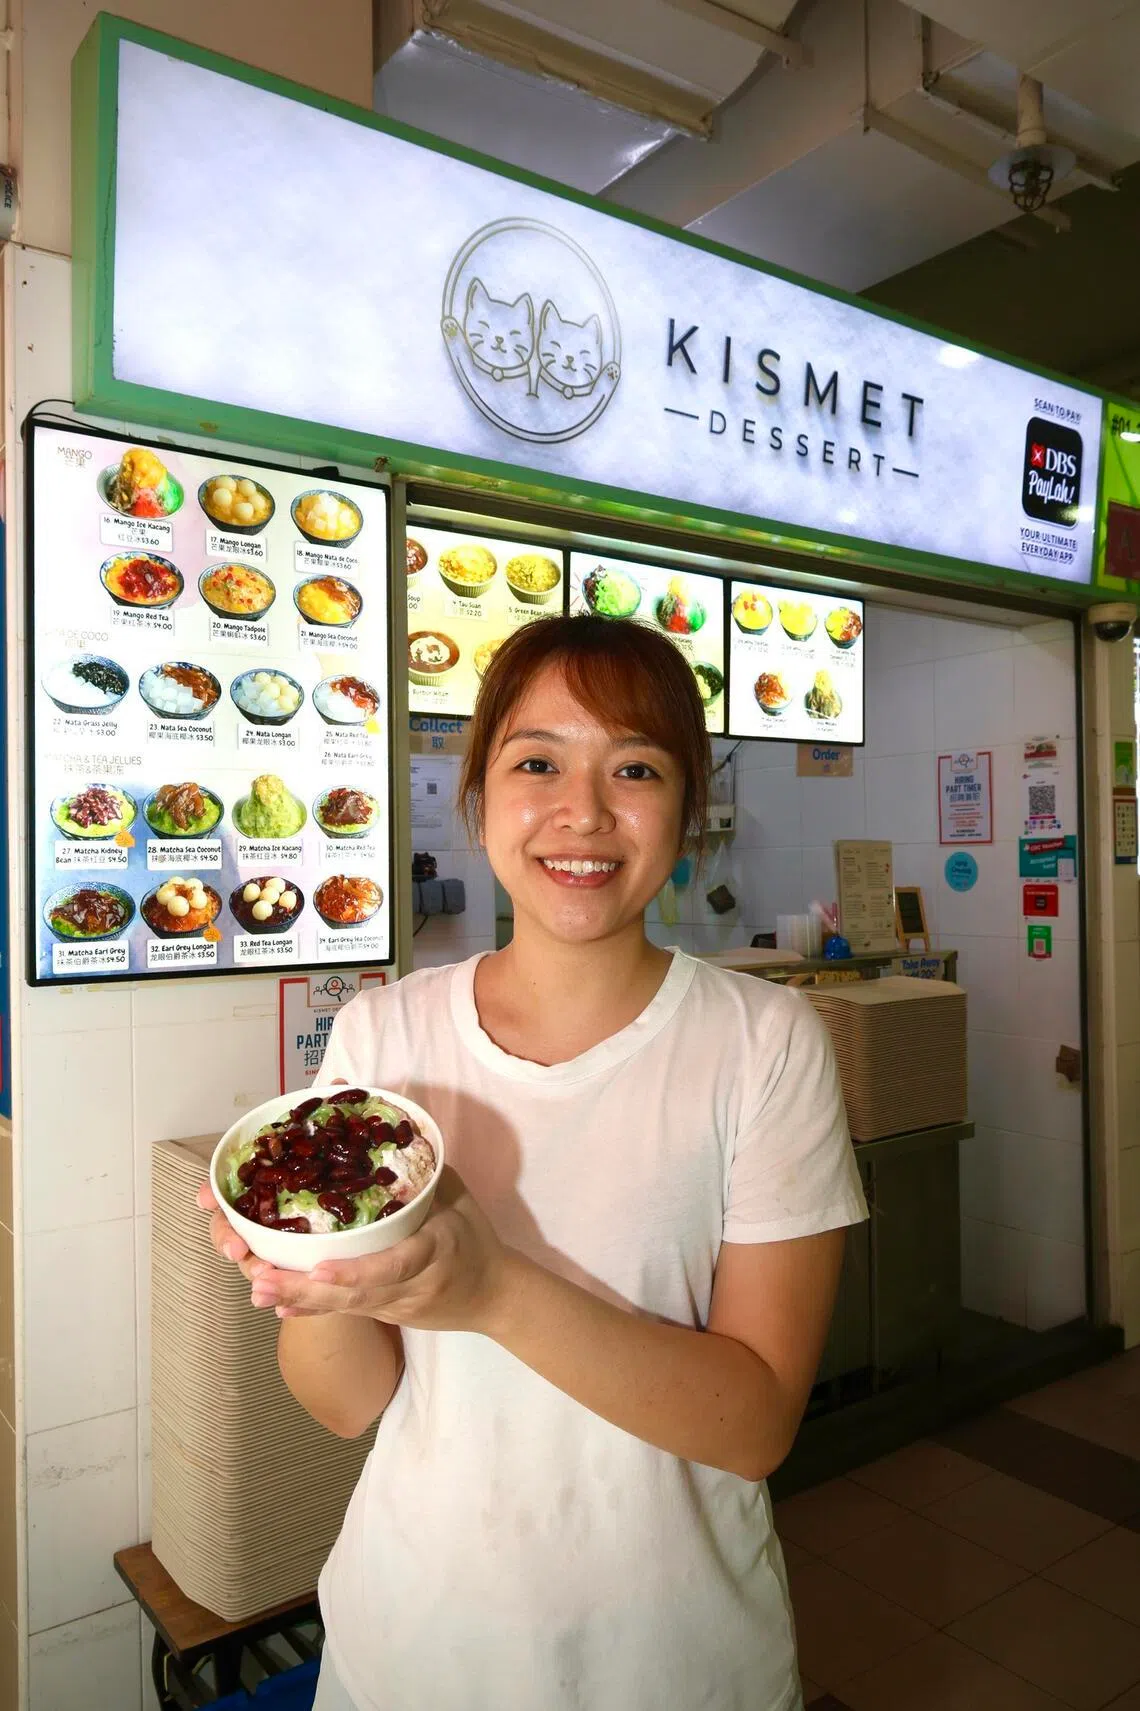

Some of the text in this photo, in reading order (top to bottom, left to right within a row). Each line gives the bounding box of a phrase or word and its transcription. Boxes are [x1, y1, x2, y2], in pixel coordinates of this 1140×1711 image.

[667, 318, 924, 437] KISMET
[1034, 398, 1054, 413] SCAN
[1055, 405, 1065, 416] TO
[709, 409, 886, 477] DESSERT
[57, 446, 93, 460] MANGO
[1046, 448, 1077, 477] DBS
[1028, 470, 1075, 504] PayLah!
[114, 518, 135, 528] Mango
[137, 520, 146, 528] Ice
[148, 522, 171, 533] Kacang
[141, 537, 160, 546] $3.60
[1020, 527, 1077, 549] YOUR ULTIMATE
[219, 537, 240, 547] Mango
[240, 540, 262, 550] Longan
[305, 551, 324, 560] Mango
[324, 553, 338, 561] Nata
[1021, 542, 1074, 561] EVERYDAY APP
[514, 607, 529, 615] Green
[123, 611, 145, 622] Mango
[145, 612, 157, 620] Red
[158, 614, 169, 622] Tea
[223, 623, 243, 633] Mango
[244, 625, 266, 634] Tadpole
[250, 634, 266, 642] $3.60
[308, 631, 327, 641] Mango
[102, 721, 118, 730] Jelly
[160, 724, 176, 732] Nata
[409, 716, 463, 734] Collect
[196, 734, 214, 742] $3.50
[271, 732, 292, 740] Longan
[278, 739, 296, 747] $3.00
[812, 748, 840, 761] Order
[955, 775, 974, 784] HIRING
[945, 784, 961, 793] PART
[74, 847, 99, 855] Matcha
[101, 847, 123, 857] Kidney
[160, 846, 184, 854] Matcha
[197, 845, 221, 853] Coconut
[282, 846, 302, 855] Kacang
[56, 856, 72, 864] Bean
[108, 855, 128, 864] $4.50
[200, 853, 219, 862] $4.50
[261, 939, 271, 947] Tea
[272, 938, 293, 948] Longan
[339, 936, 353, 946] Grey
[94, 947, 108, 955] Earl
[109, 947, 126, 957] Grey
[161, 944, 175, 952] Earl
[175, 944, 191, 953] Grey
[192, 943, 214, 952] Longan
[276, 946, 293, 955] $3.50
[106, 955, 126, 964] $4.50
[197, 951, 215, 959] $3.50
[316, 1016, 334, 1032] HIR
[296, 1033, 329, 1049] PART
